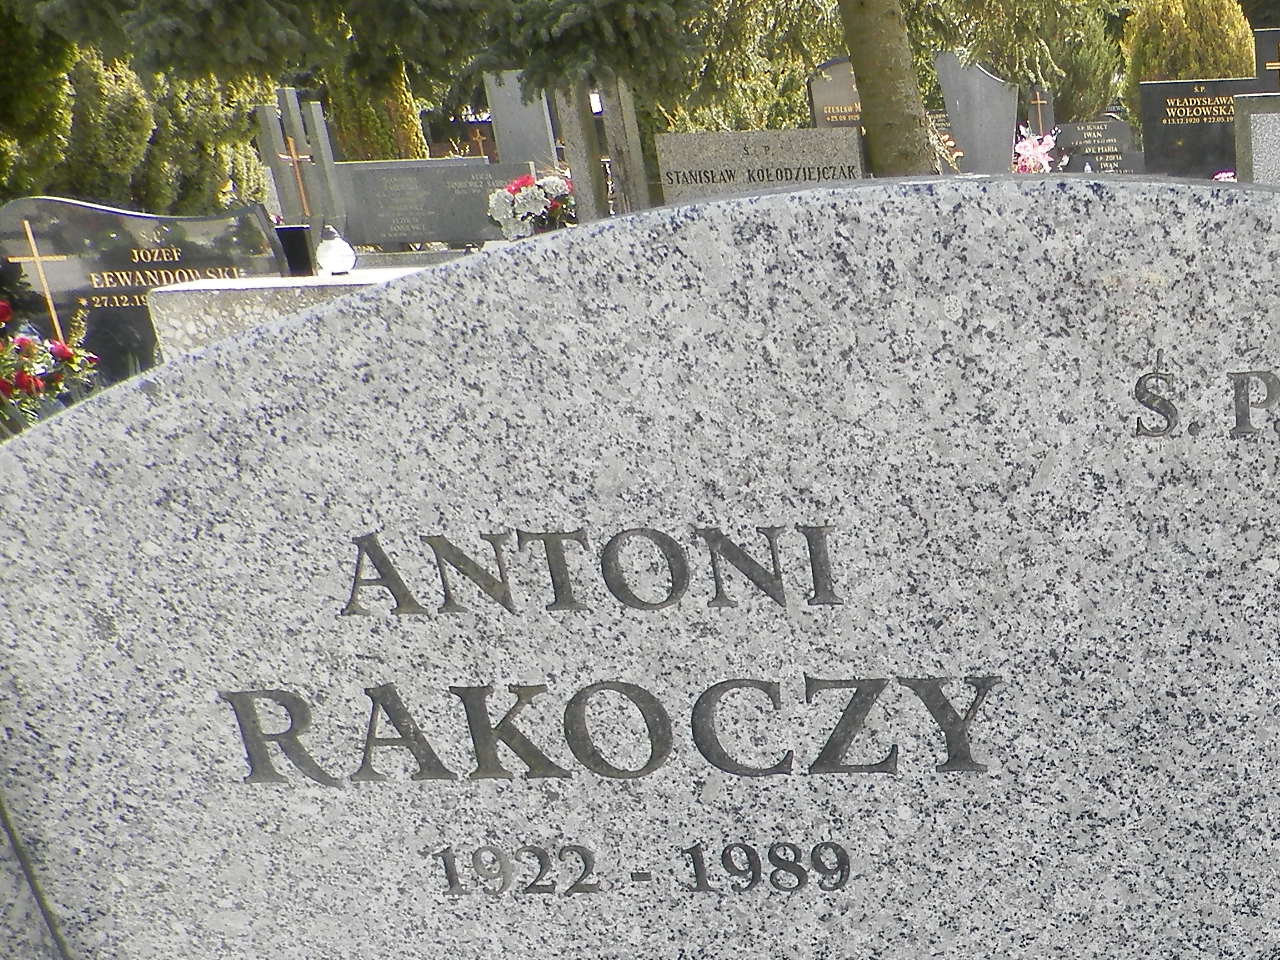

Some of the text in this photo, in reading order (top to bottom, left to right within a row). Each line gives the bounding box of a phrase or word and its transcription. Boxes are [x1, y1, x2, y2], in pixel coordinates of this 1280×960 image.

[1166, 105, 1236, 118] WOŁOWSKA
[1083, 131, 1103, 139] IWAN
[665, 165, 857, 185] STANISŁAW KOŁODZIEJCZAK
[1100, 161, 1120, 169] IWAN
[340, 523, 845, 617] ANTONI
[219, 672, 1001, 788] RAKOCZY
[434, 844, 599, 897] 1922
[681, 840, 851, 893] 1989
